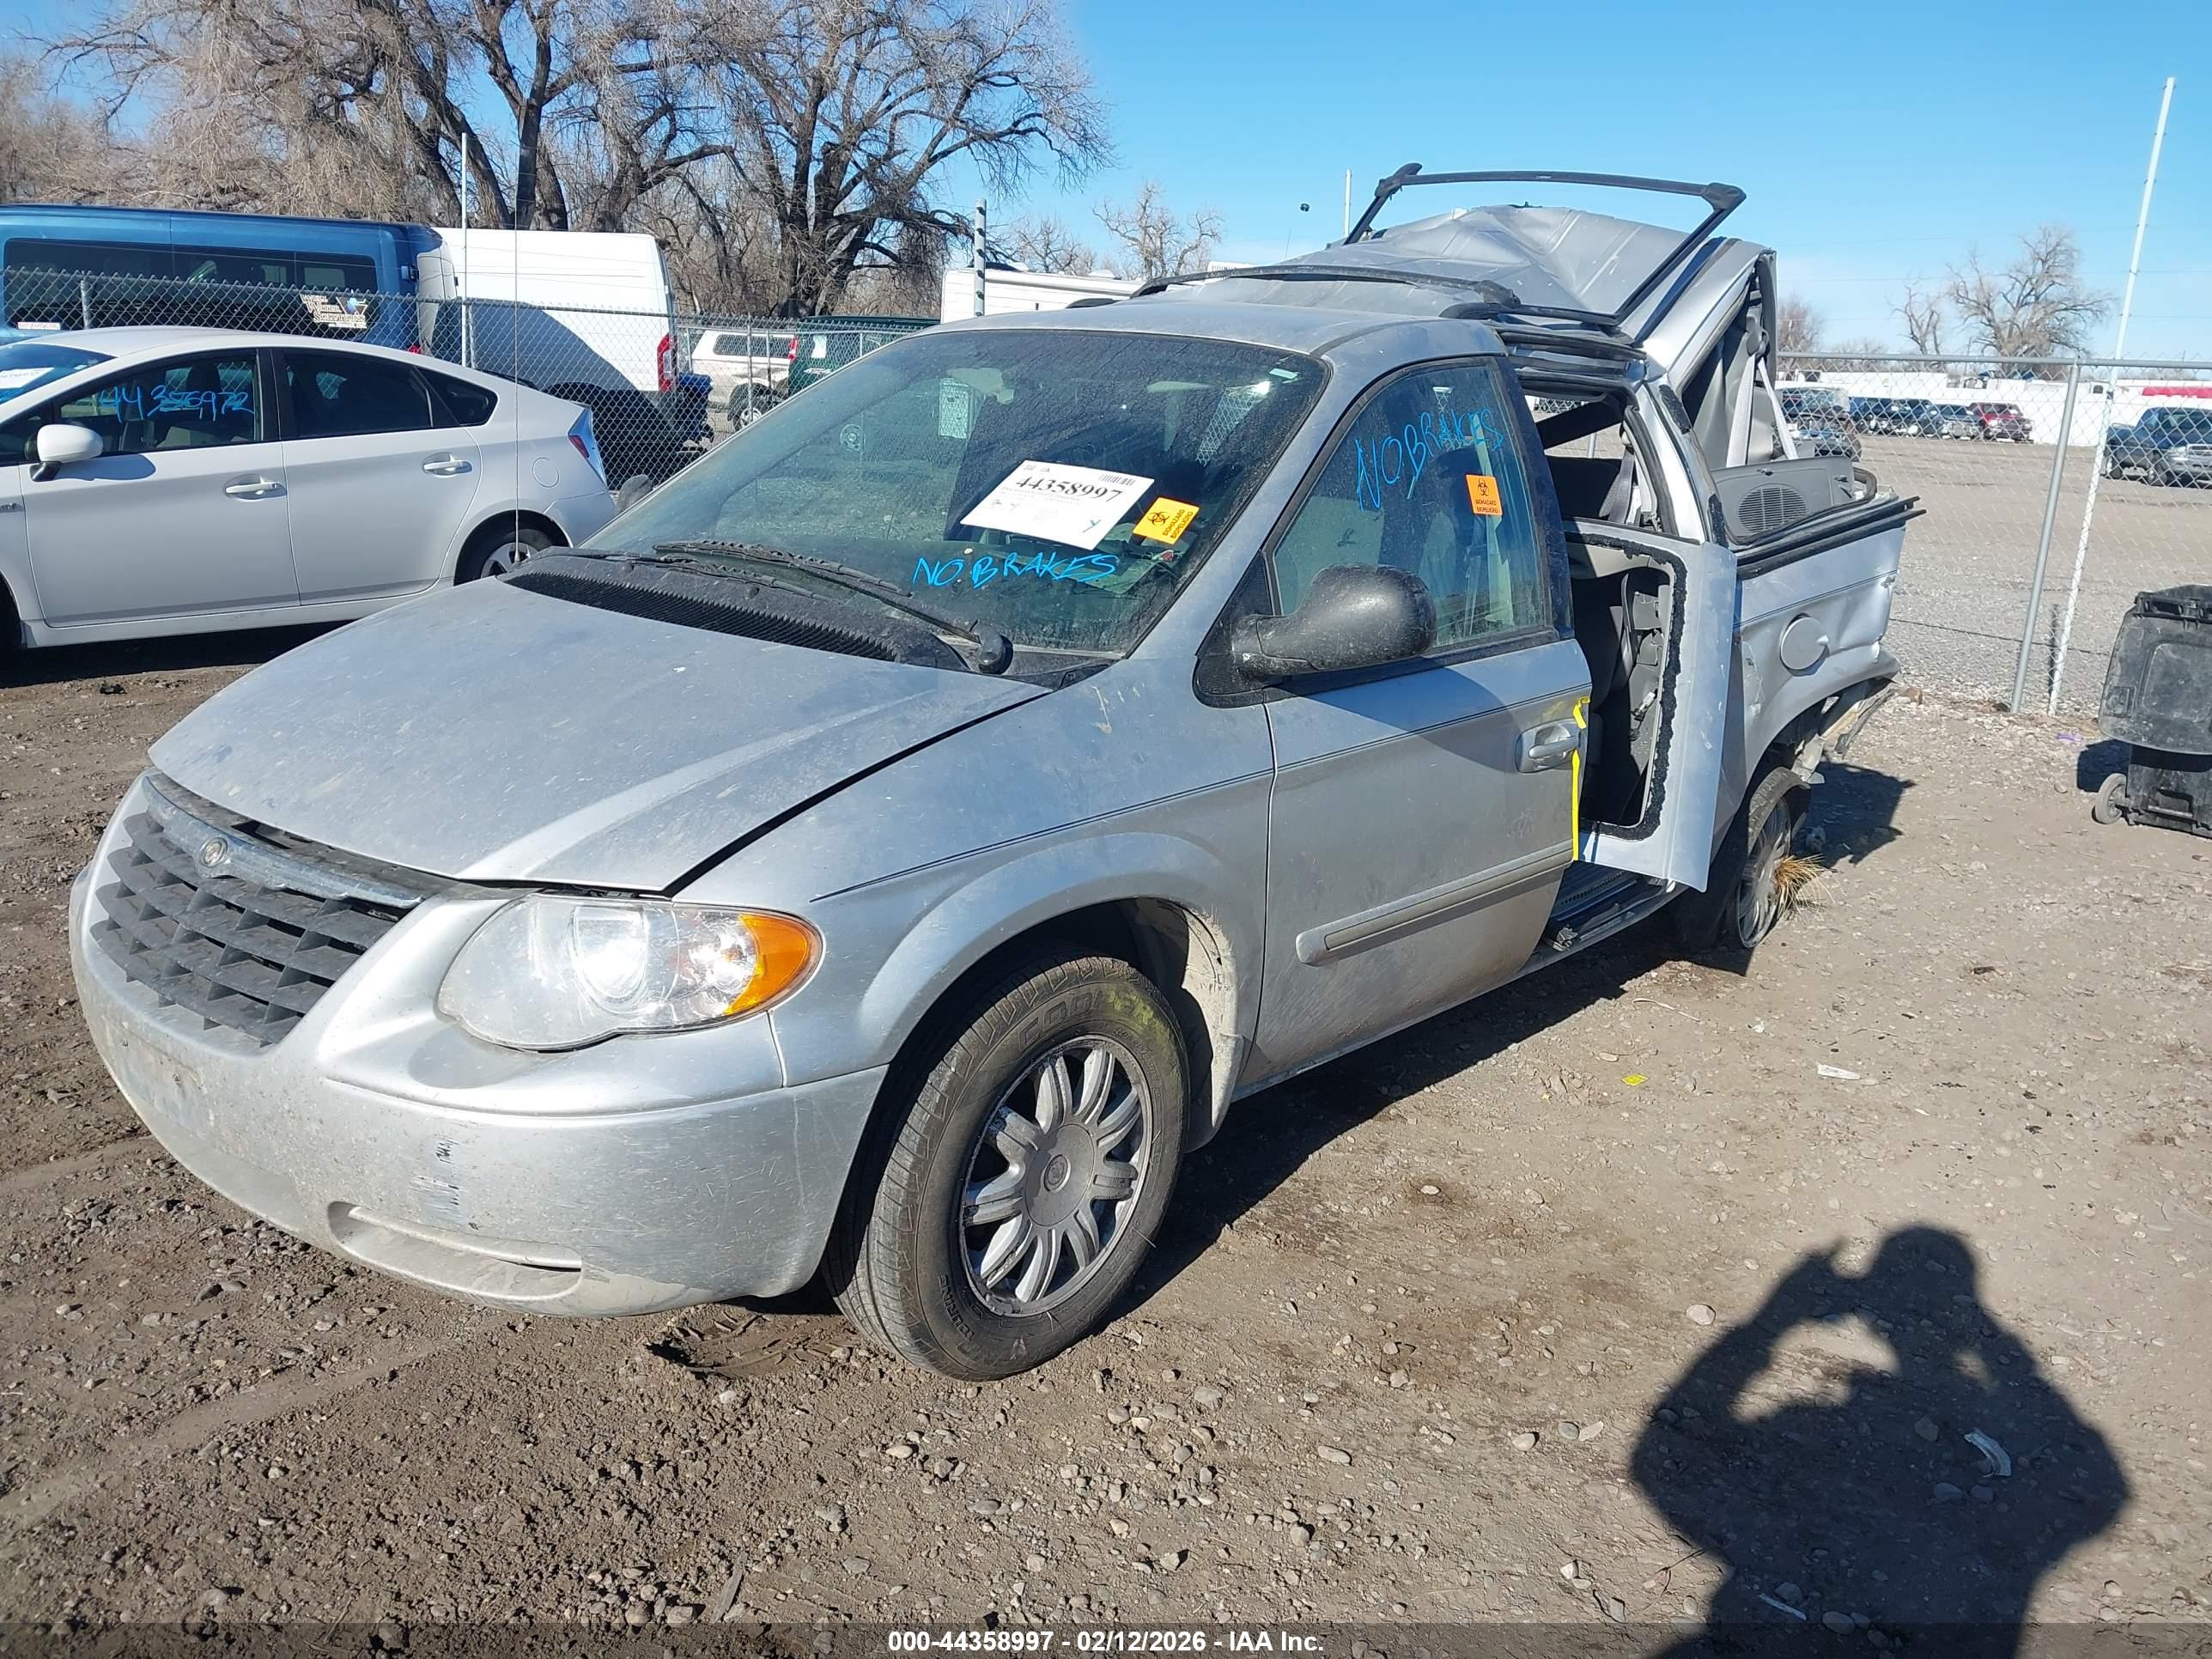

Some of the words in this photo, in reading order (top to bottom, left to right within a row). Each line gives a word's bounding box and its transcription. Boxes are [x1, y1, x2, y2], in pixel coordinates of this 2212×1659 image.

[1016, 477, 1123, 502] 44358997
[912, 556, 965, 586] NO
[971, 551, 1120, 589] BRAKES
